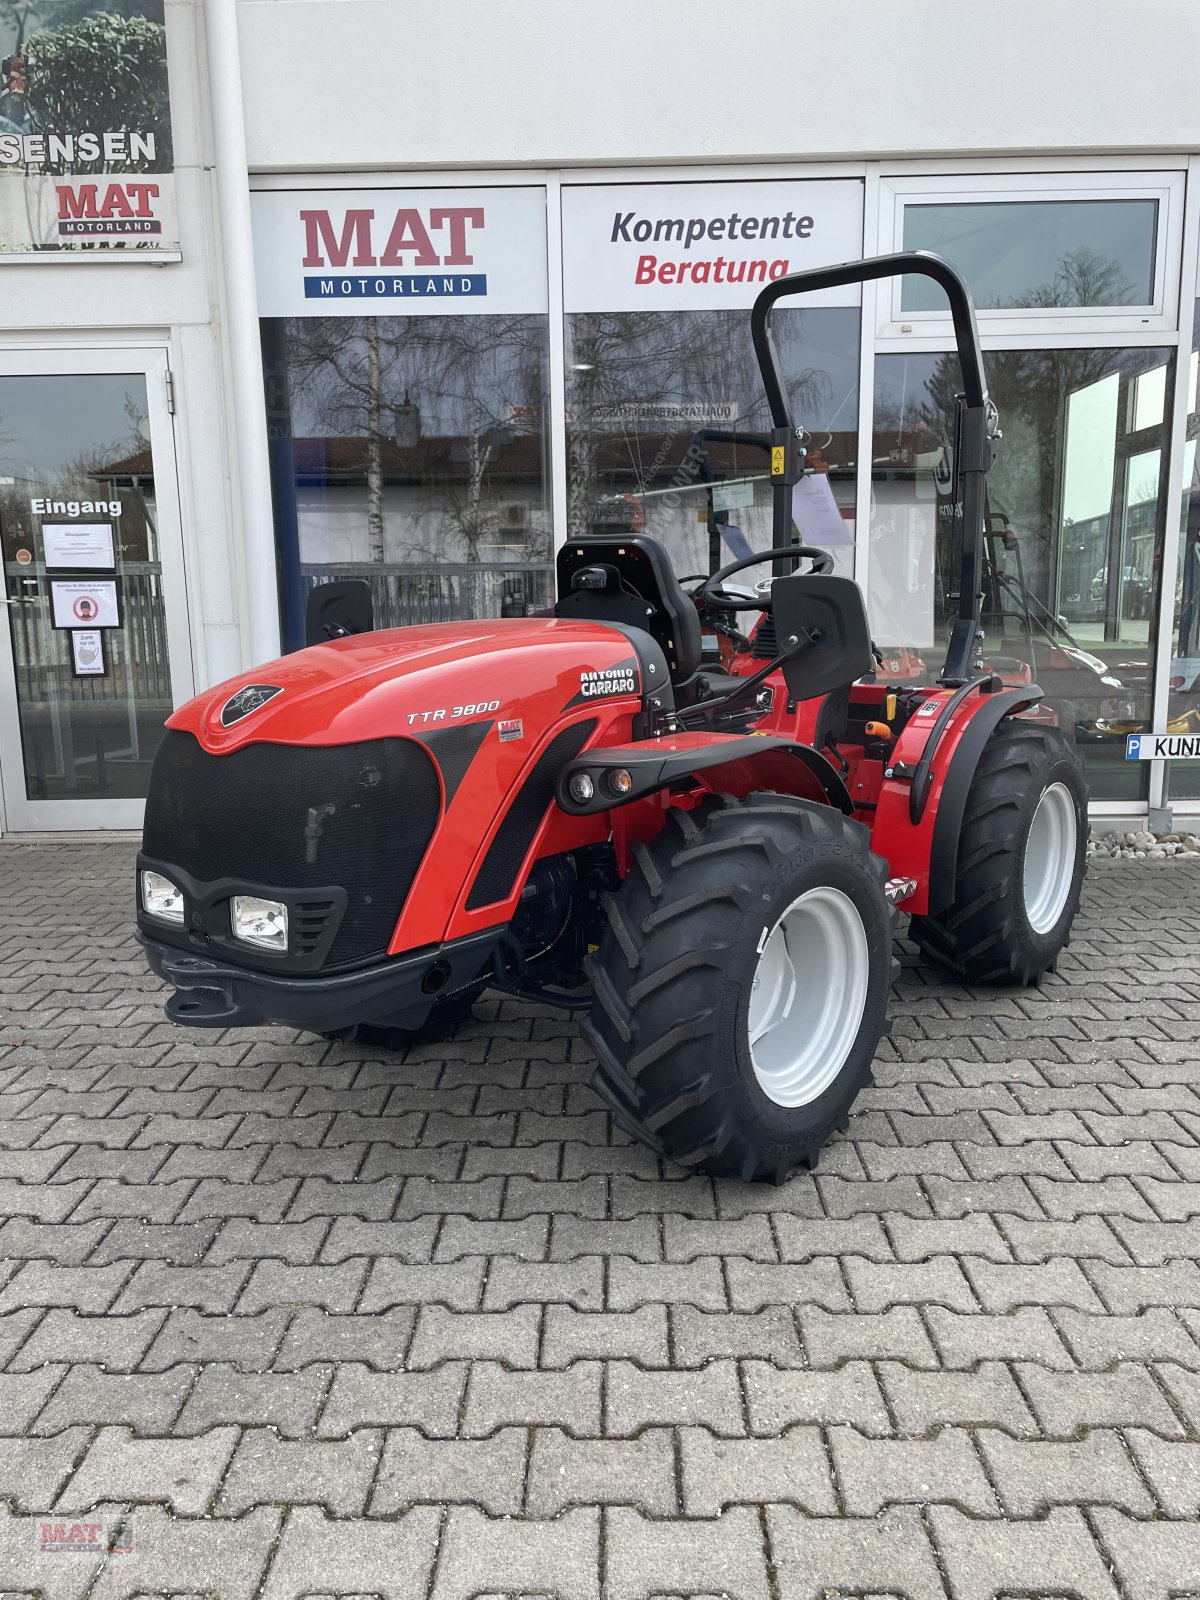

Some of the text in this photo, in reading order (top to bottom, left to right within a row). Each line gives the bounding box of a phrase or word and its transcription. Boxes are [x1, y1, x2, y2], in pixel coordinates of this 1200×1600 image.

[0, 132, 156, 164] SENSEN
[55, 183, 160, 219] MAT
[66, 221, 152, 233] MOTORLAND
[300, 207, 485, 267] MAT
[610, 211, 814, 249] Kompetente
[320, 278, 473, 295] MOTORLAND
[31, 498, 122, 517] Eingang
[580, 678, 635, 697] CARRARO
[406, 700, 500, 725] TTR 3800
[1128, 739, 1140, 755] P
